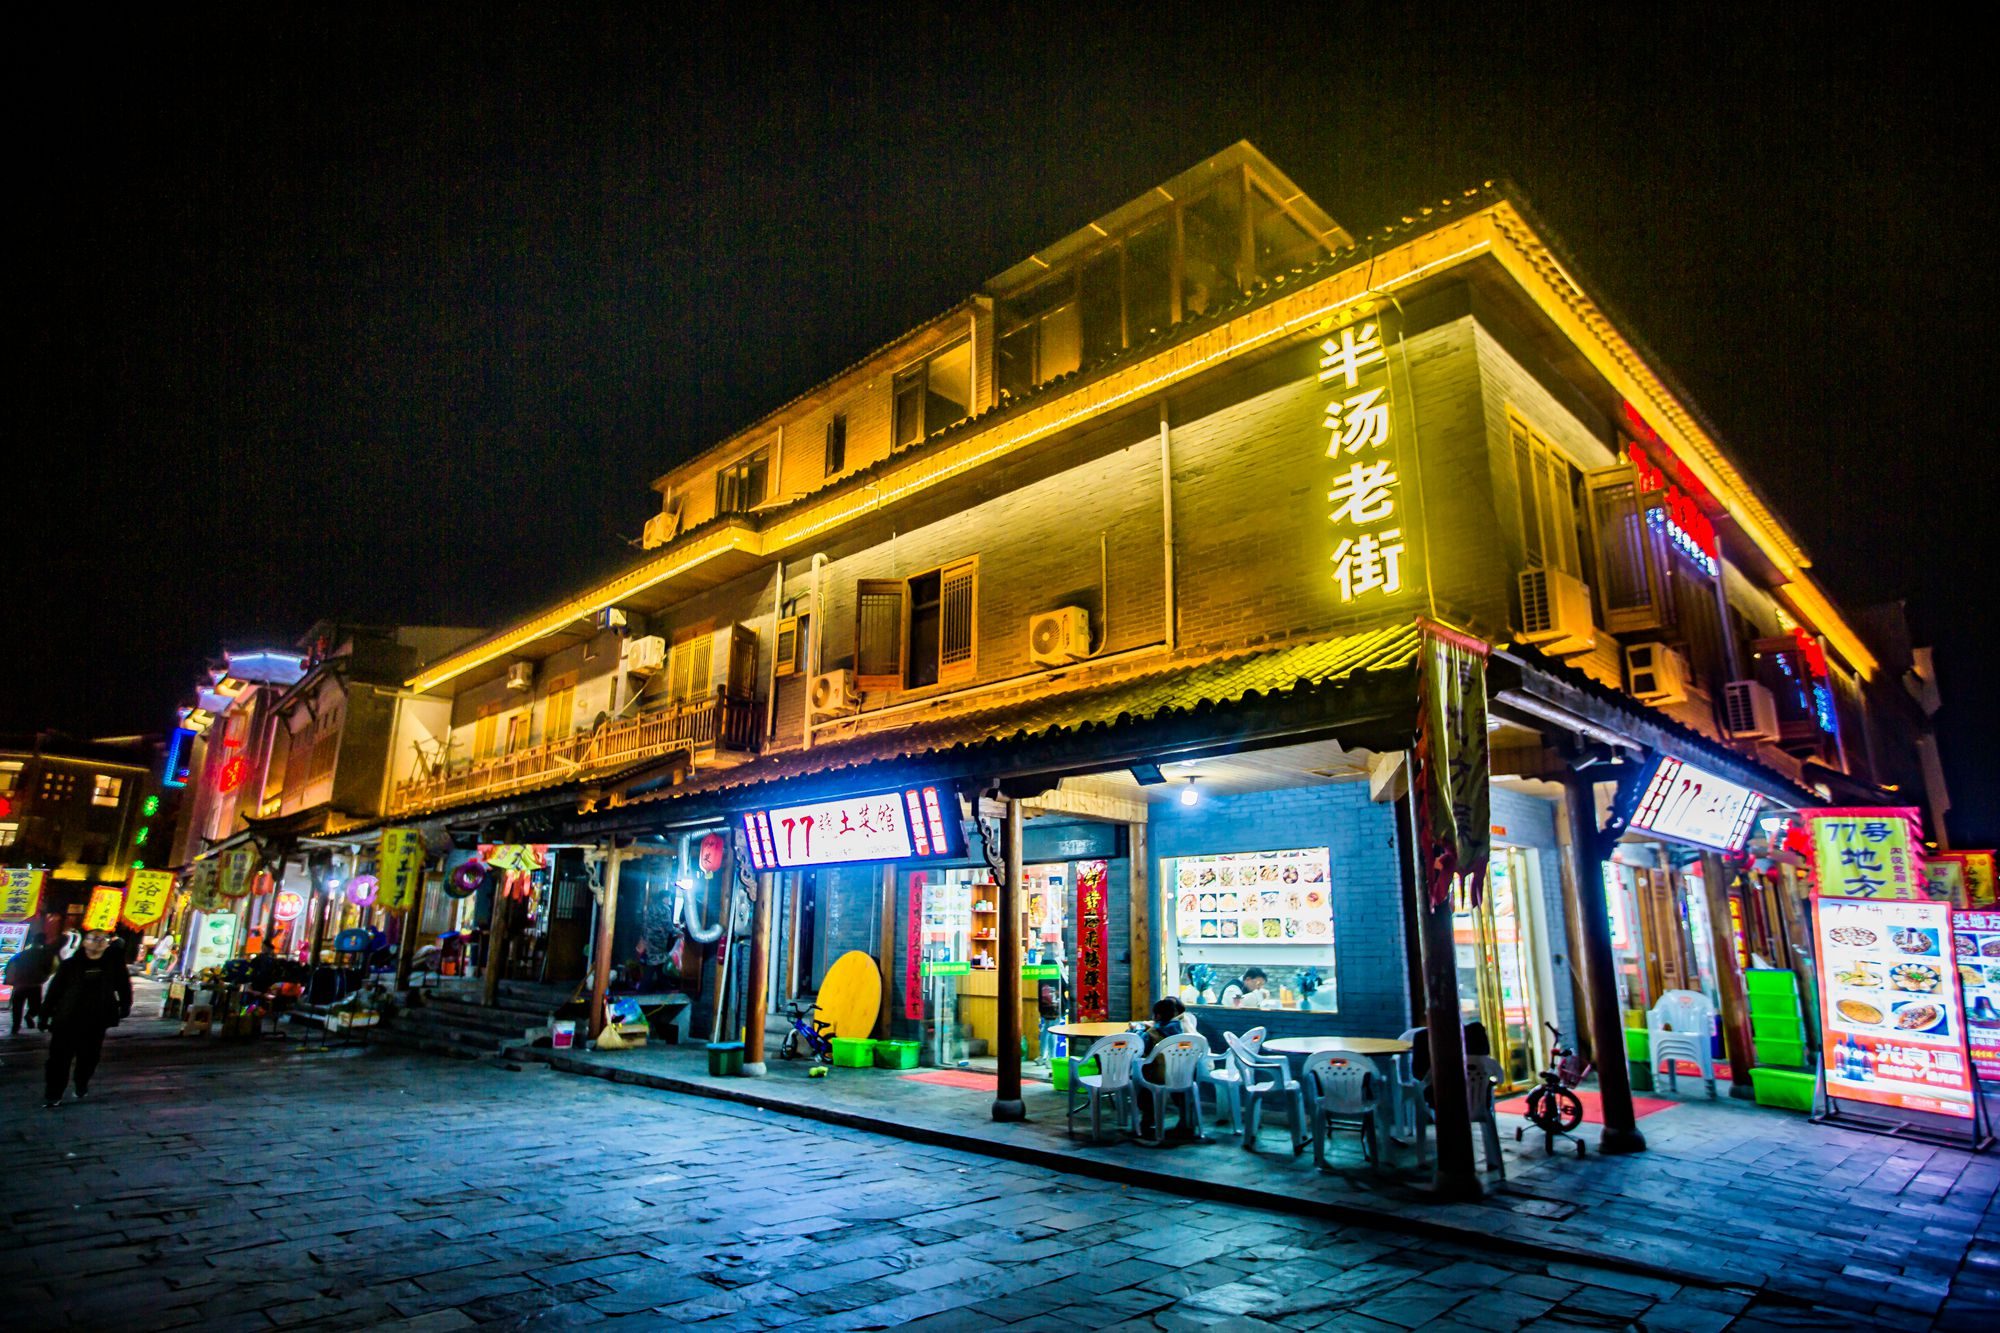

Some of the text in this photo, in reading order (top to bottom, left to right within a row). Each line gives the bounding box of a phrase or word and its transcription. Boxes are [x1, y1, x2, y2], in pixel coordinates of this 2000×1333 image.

[1318, 322, 1405, 604] 半汤老街
[132, 881, 161, 915] 浴室
